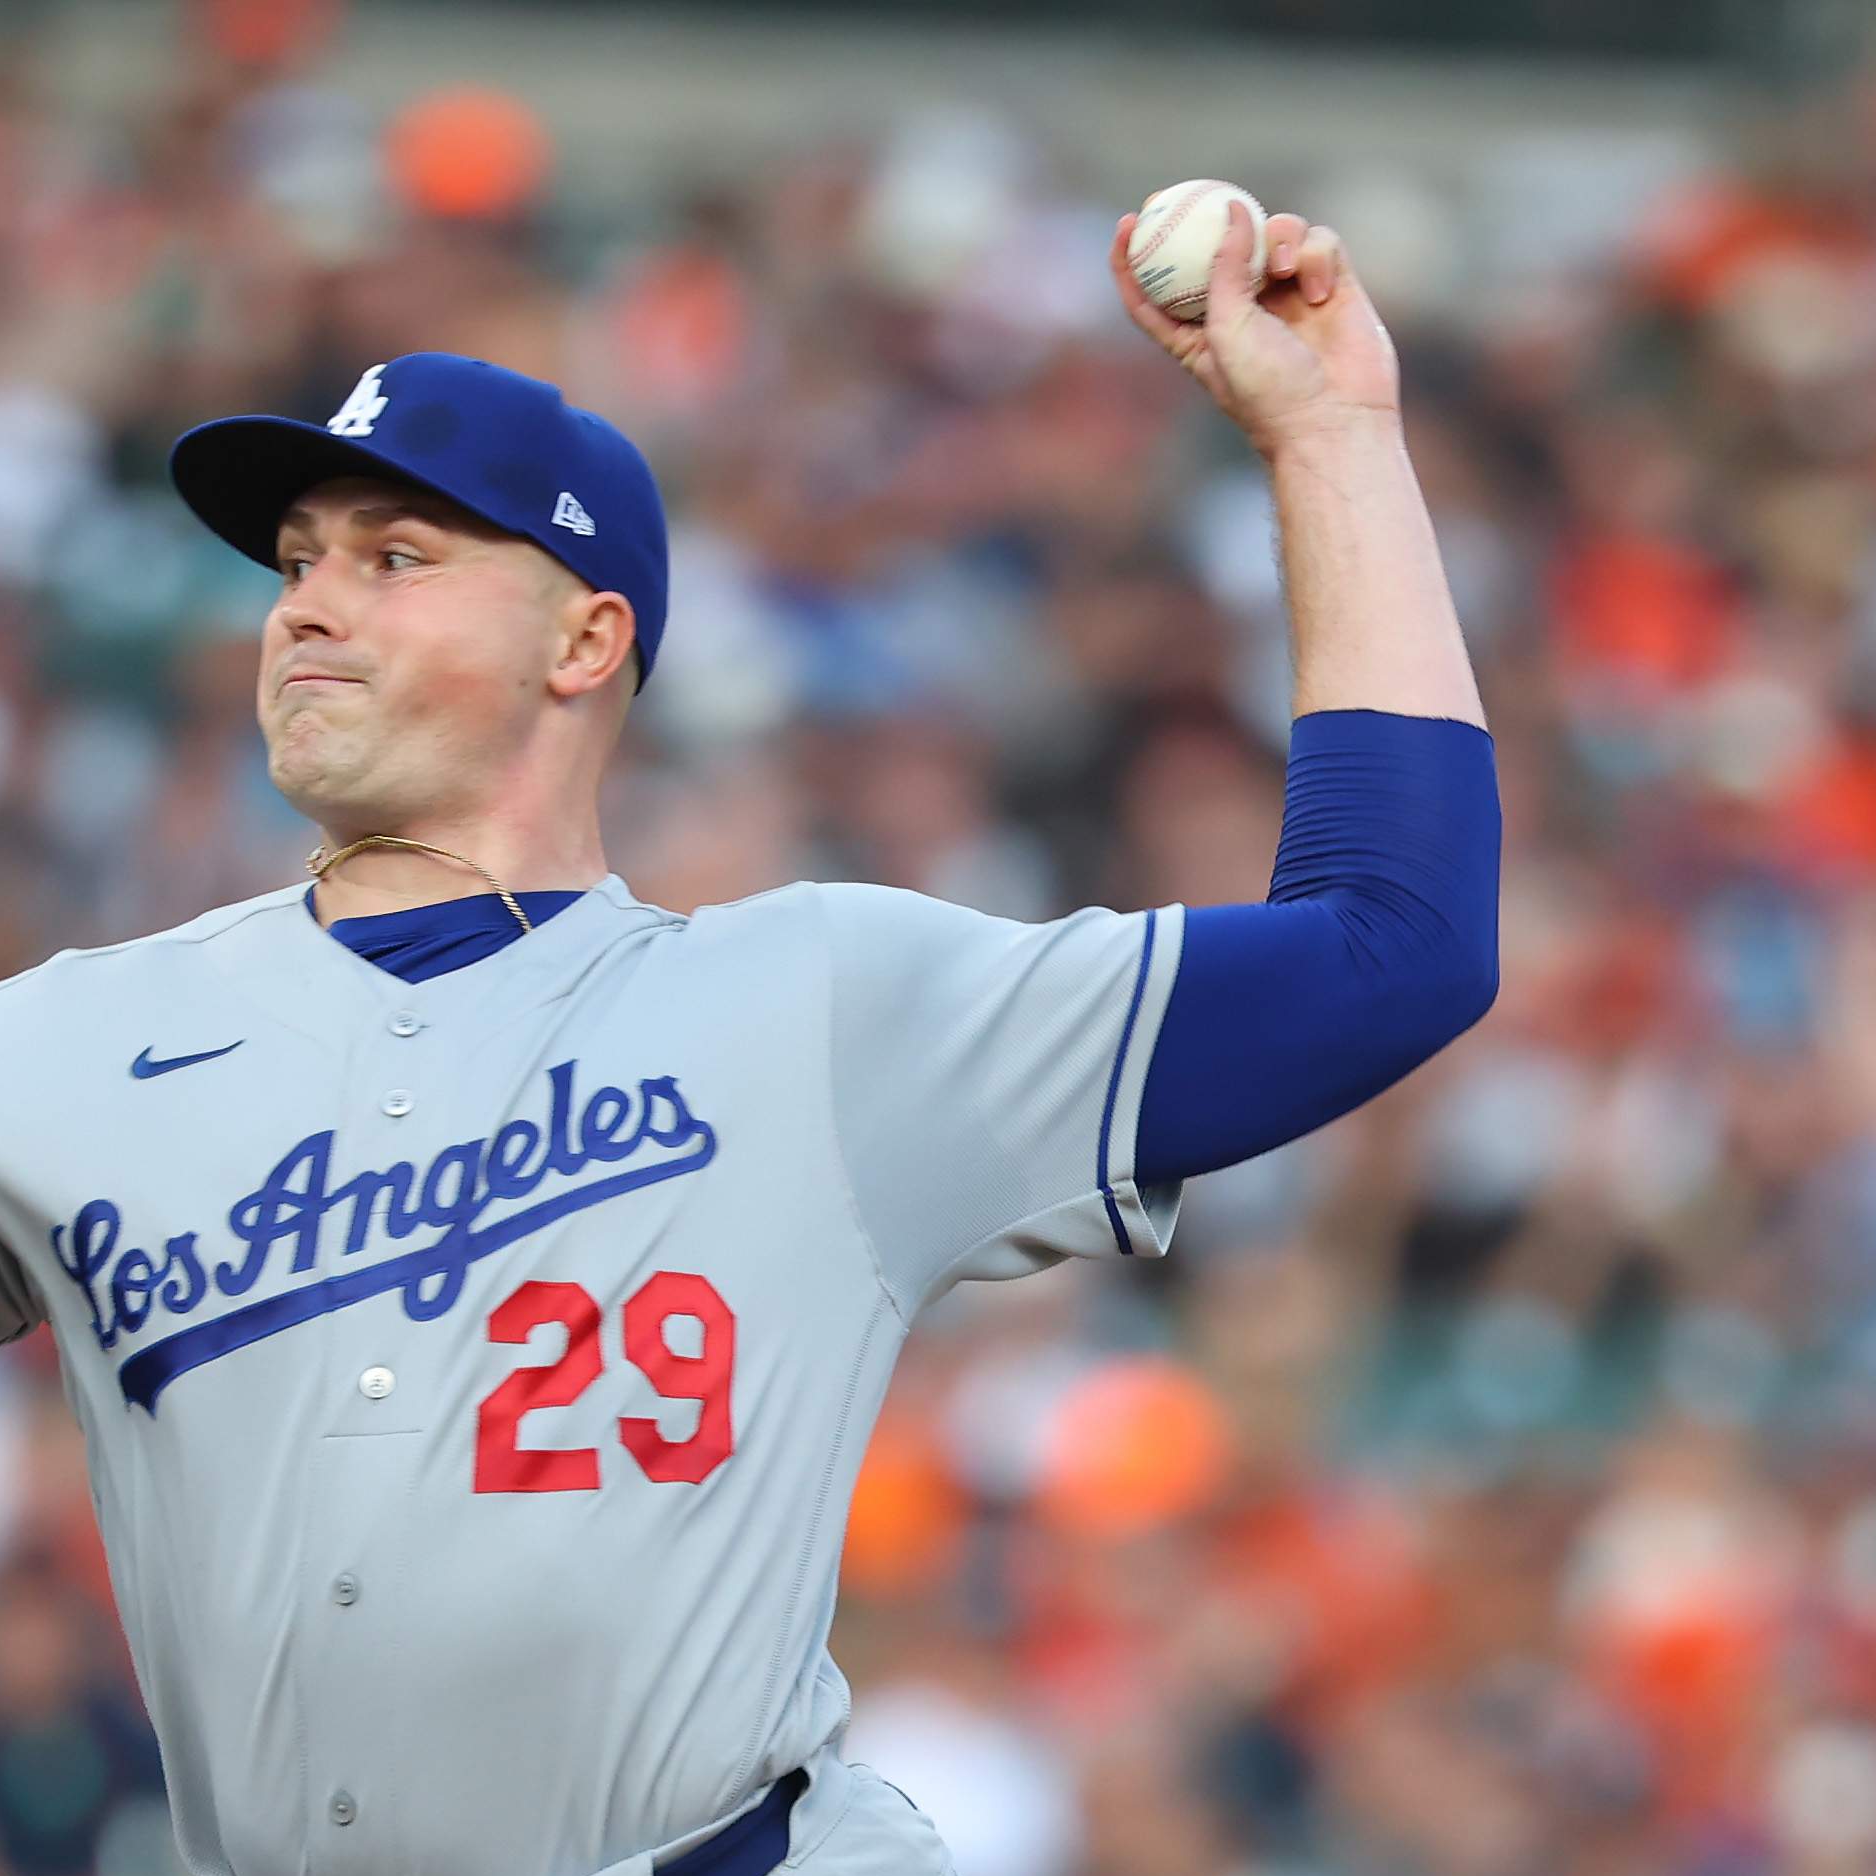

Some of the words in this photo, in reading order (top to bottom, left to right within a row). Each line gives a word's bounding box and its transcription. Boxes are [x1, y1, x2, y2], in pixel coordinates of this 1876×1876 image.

[51, 1199, 207, 1350] Los
[215, 1058, 718, 1322] Angeles
[473, 1270, 736, 1493] 29
